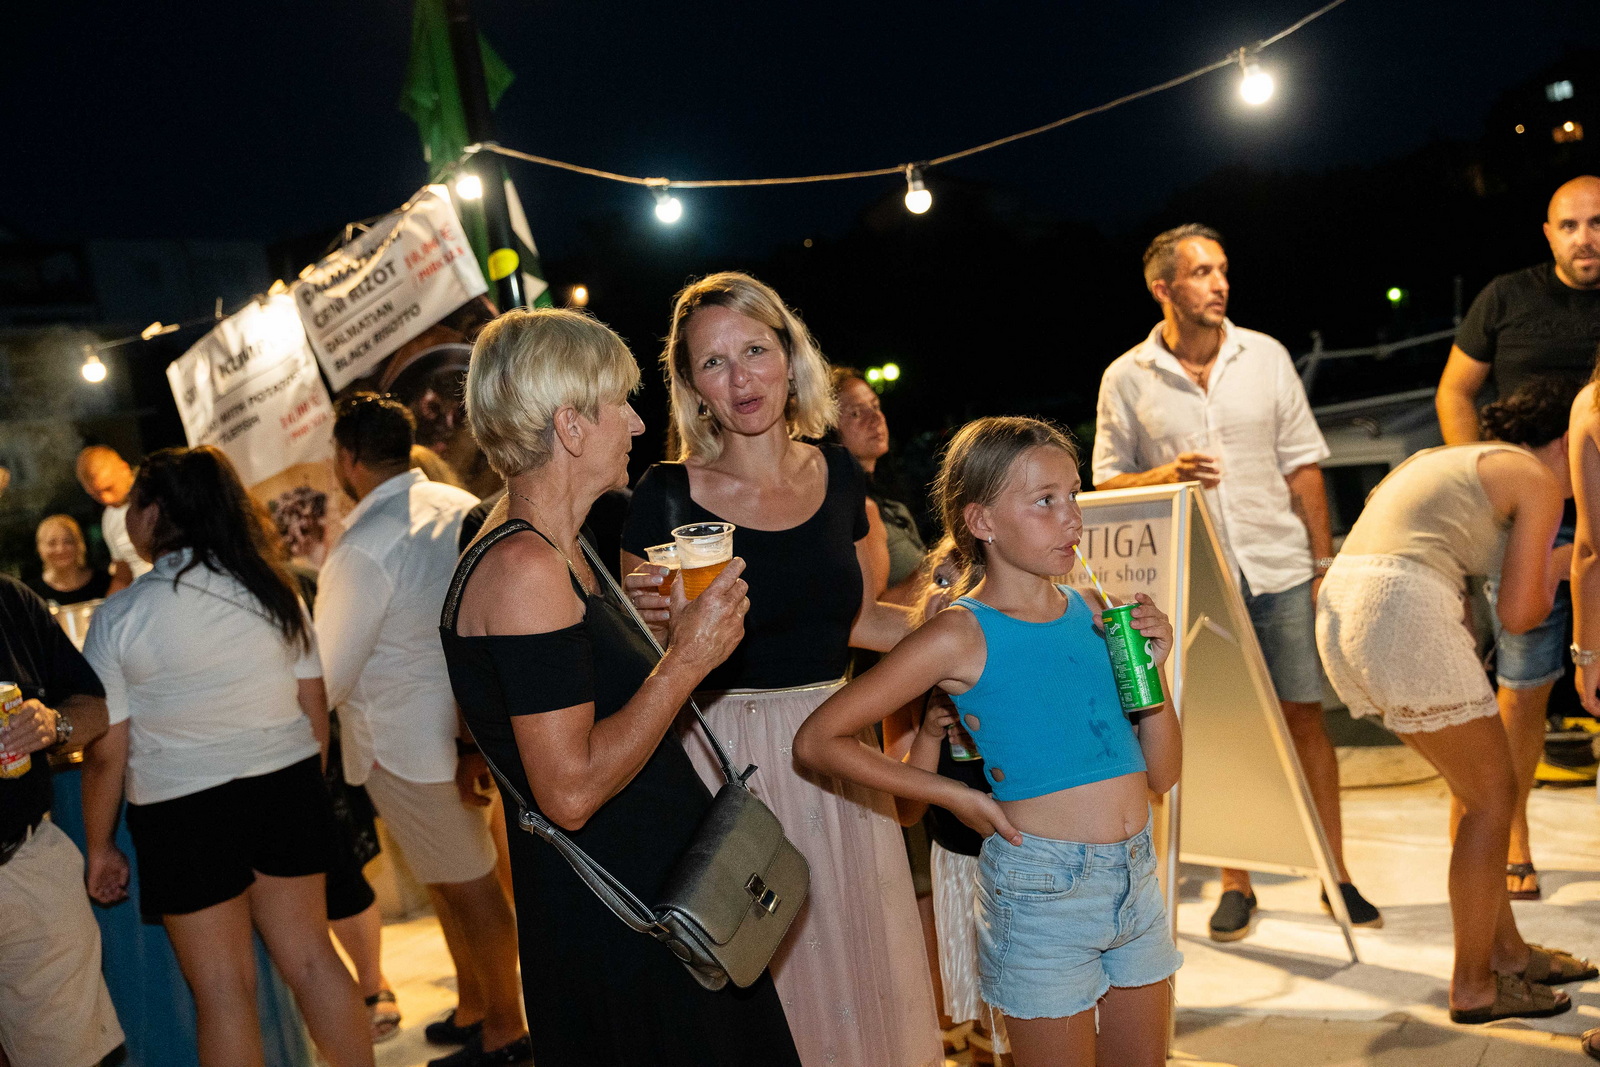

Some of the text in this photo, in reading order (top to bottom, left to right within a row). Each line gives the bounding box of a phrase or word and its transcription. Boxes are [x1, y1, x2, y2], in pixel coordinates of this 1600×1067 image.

[324, 301, 394, 354] DALMATIAN
[1083, 523, 1157, 559] TIGA
[1051, 564, 1156, 585] uvenir shop
